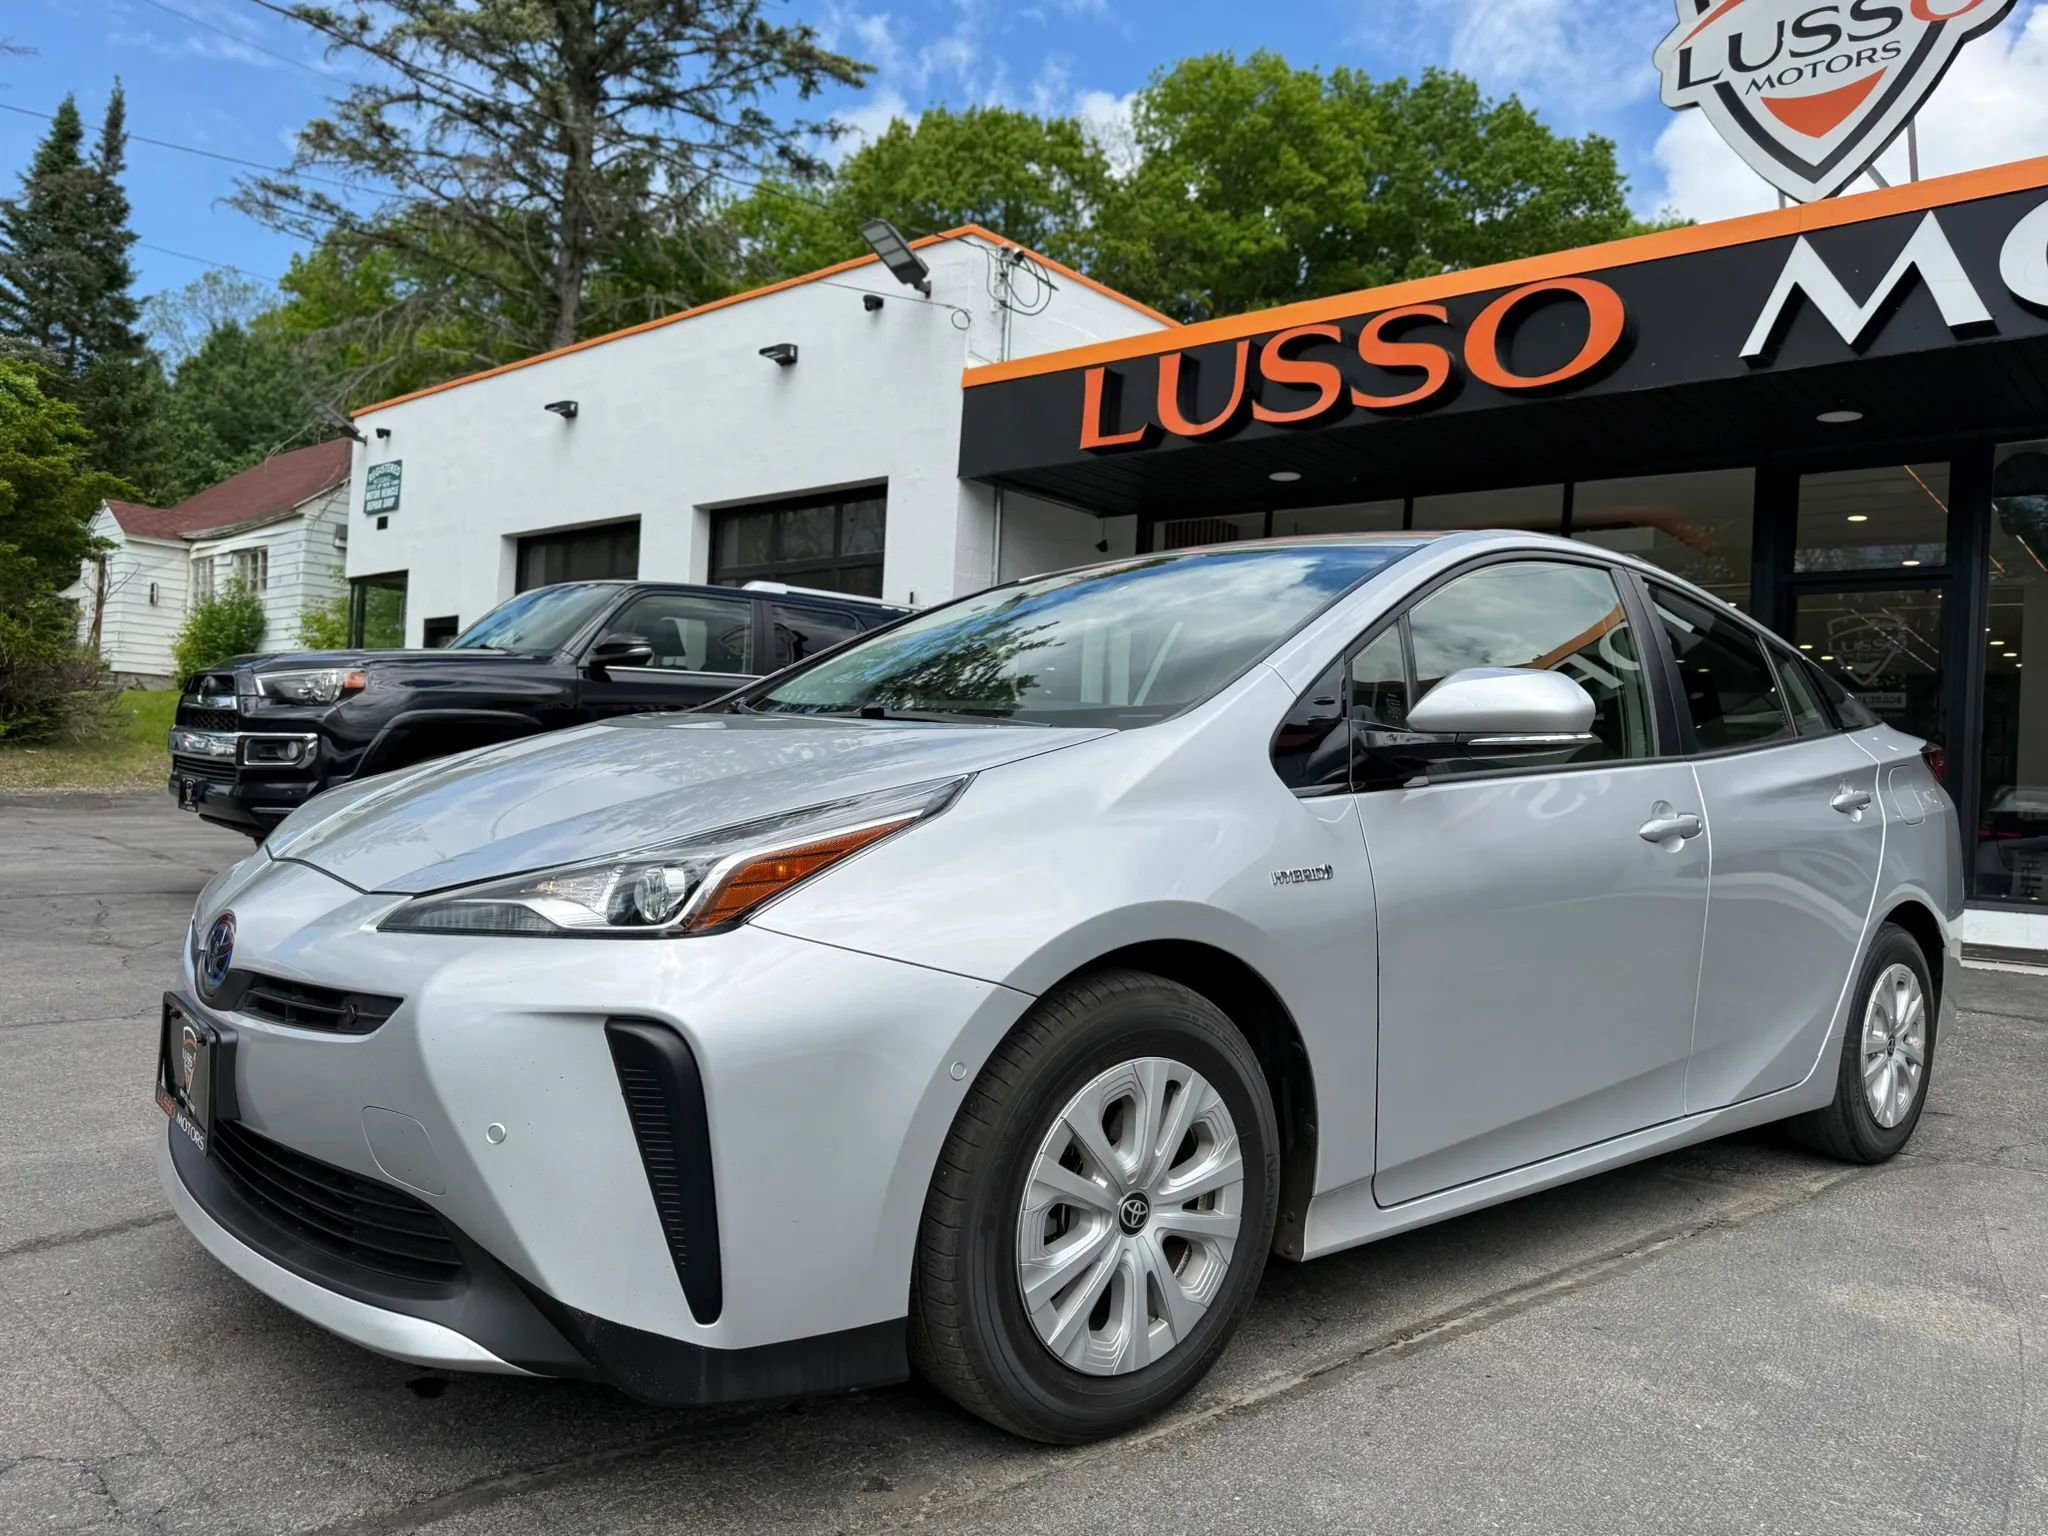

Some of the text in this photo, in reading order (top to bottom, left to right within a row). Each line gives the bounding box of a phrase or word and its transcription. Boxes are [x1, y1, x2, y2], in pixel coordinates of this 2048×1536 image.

[1745, 40, 1902, 95] MOTORS
[1079, 198, 2048, 450] LUSSO M
[1270, 864, 1334, 887] HYBRID
[176, 1112, 205, 1151] MOTORS
